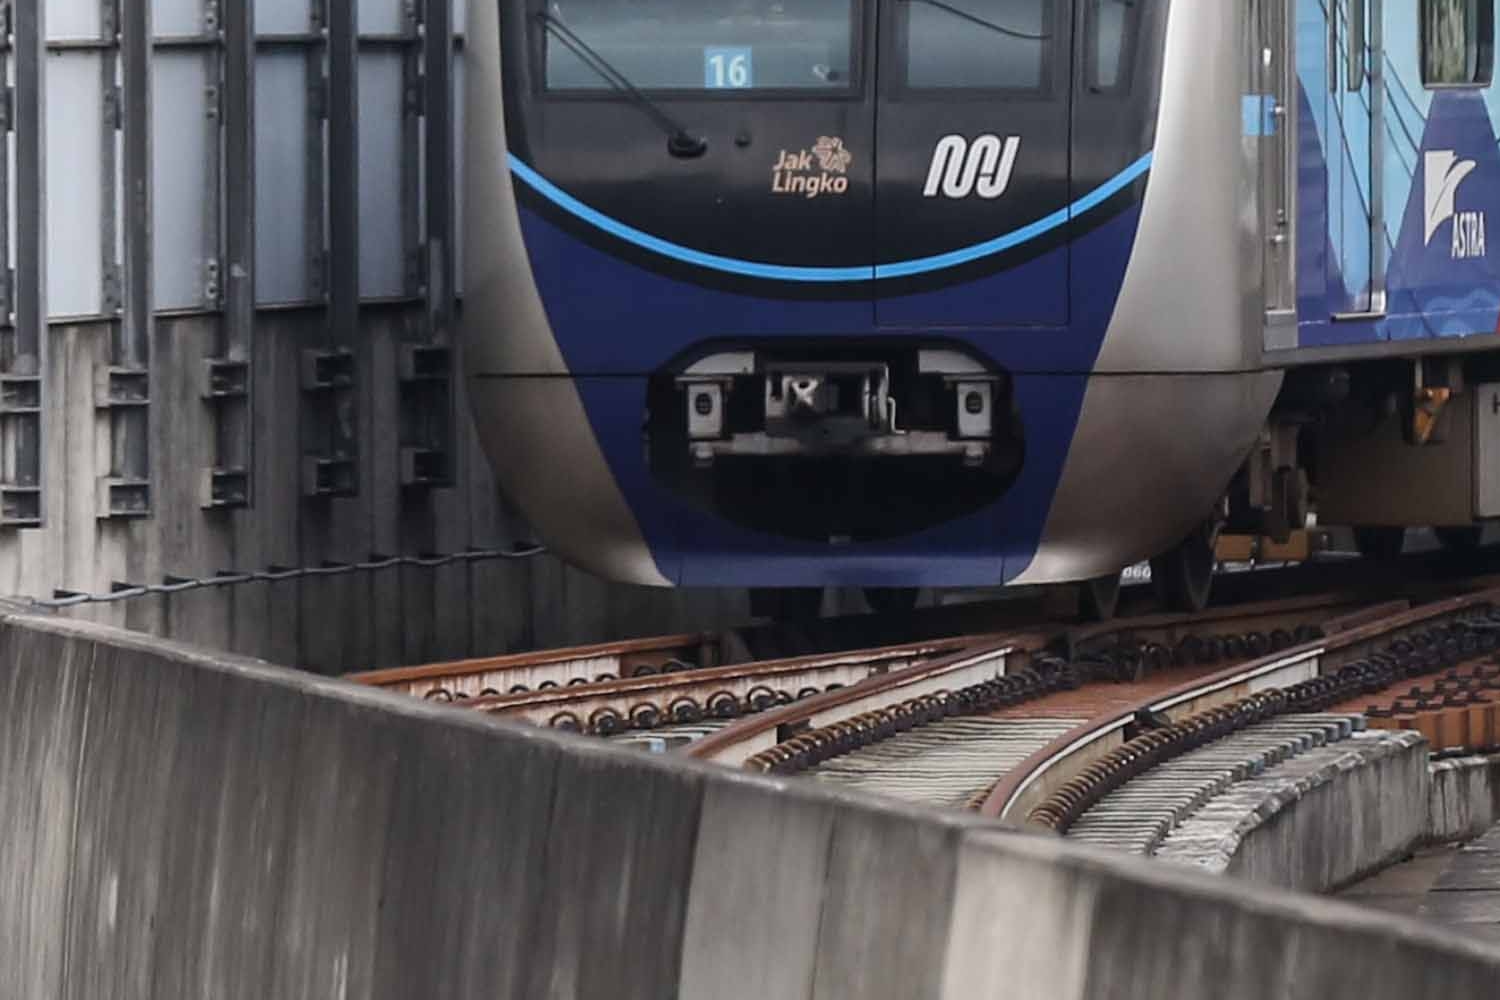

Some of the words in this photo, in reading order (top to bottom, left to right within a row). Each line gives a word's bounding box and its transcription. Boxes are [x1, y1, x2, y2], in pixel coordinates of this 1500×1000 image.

[709, 55, 746, 88] 16
[773, 150, 811, 172] Jak
[772, 171, 848, 199] Lingko
[1451, 211, 1485, 258] ASTRA
